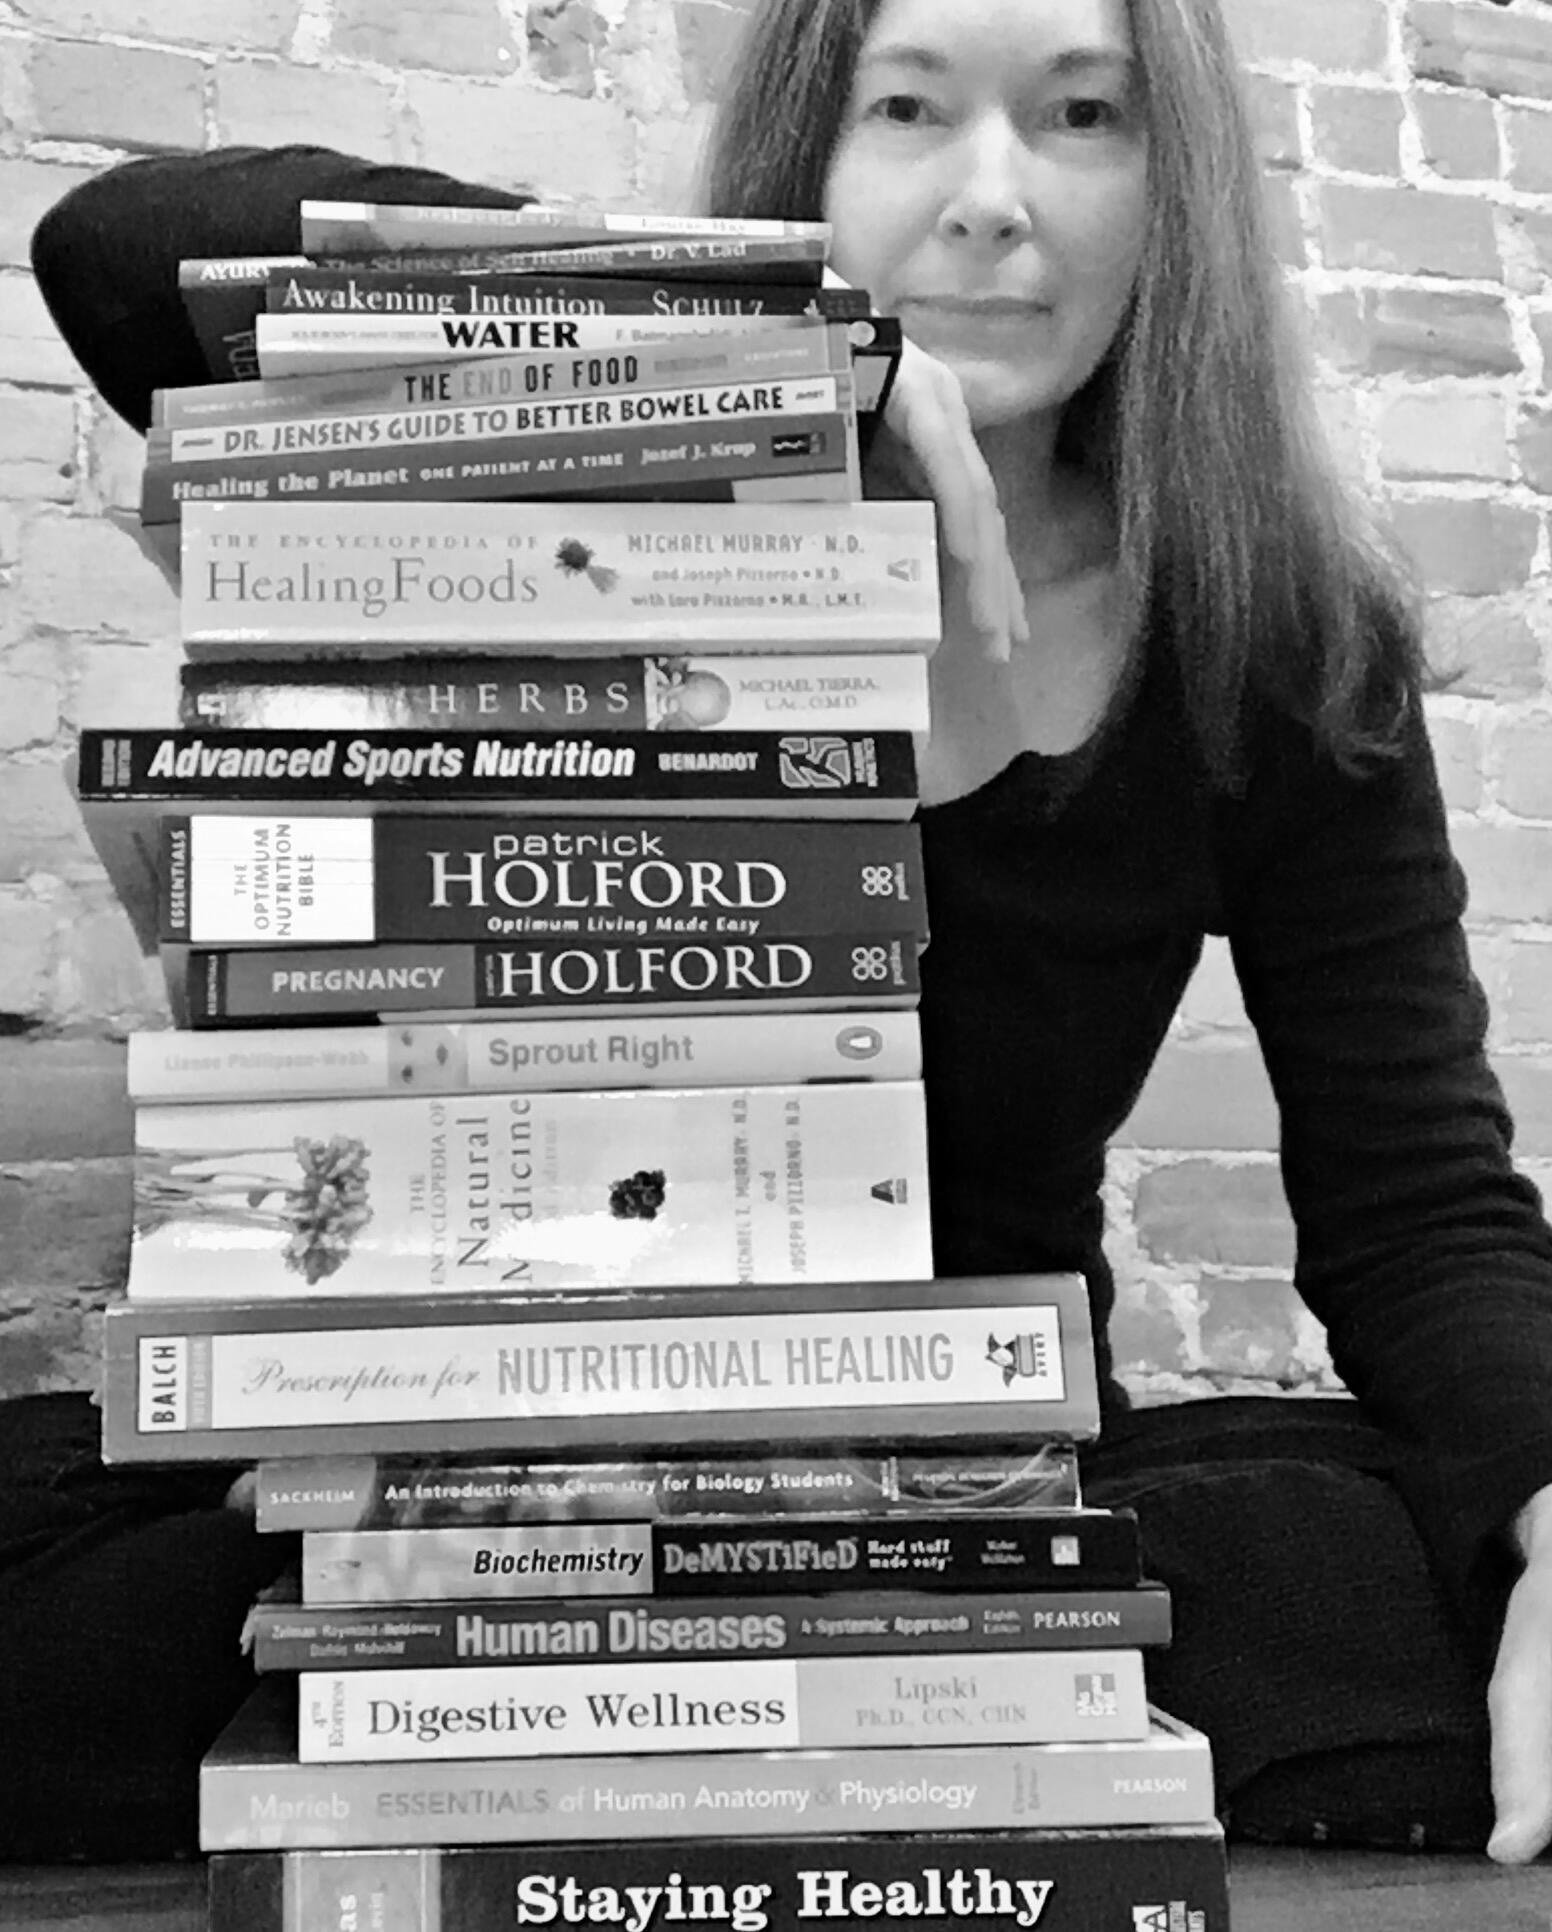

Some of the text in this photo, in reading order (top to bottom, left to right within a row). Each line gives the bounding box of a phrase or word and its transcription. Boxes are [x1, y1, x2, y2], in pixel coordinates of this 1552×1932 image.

[708, 240, 746, 258] Lad
[282, 278, 455, 315] Awakening
[470, 284, 604, 315] Intuition
[441, 320, 579, 349] WATER
[404, 373, 452, 402] THE
[463, 366, 511, 397] END
[524, 362, 554, 393] OF
[572, 355, 638, 389] FOOD
[272, 419, 380, 452] JENSEN'S
[387, 411, 466, 441] GUIDE
[473, 409, 507, 431] TO
[516, 401, 611, 430] BETTER
[620, 393, 710, 422] BOWEL
[717, 385, 784, 413] CARE
[172, 477, 270, 500] Healing
[278, 472, 319, 492] the
[328, 466, 409, 488] Planet
[419, 465, 455, 481] ONE
[461, 460, 531, 478] PATIENT
[536, 458, 557, 472] AT
[563, 457, 576, 470] A
[581, 452, 624, 468] TIME
[210, 534, 539, 550] THE ENCYCLOPEDIA OF
[627, 533, 715, 554] MICHAEL
[722, 533, 803, 554] MURRAY
[652, 566, 680, 581] and
[630, 592, 665, 606] with
[428, 681, 630, 716] HERBS
[738, 679, 814, 693] MICHAEL
[147, 739, 337, 779] Advanced
[342, 739, 465, 786] Sports
[472, 739, 636, 778] Nutrition
[658, 751, 759, 772] BENARDOT
[492, 829, 665, 860] patrick
[169, 829, 187, 929] ESSENTIALS
[233, 863, 248, 896] THE
[253, 827, 270, 931] OPTIMUM
[276, 823, 292, 937] NUTRITION
[298, 853, 315, 907] BIBLE
[426, 850, 788, 909] HOLFORD
[486, 915, 760, 935] Optimum Living Made Easy
[271, 966, 445, 993] PREGNANCY
[499, 943, 813, 997] HOLFORD
[488, 1032, 694, 1071] Sprout Right
[429, 1099, 447, 1127] OF
[409, 1172, 426, 1214] THE
[455, 1115, 490, 1268] Natural
[499, 1098, 533, 1284] Mdicine
[759, 1170, 776, 1202] and
[152, 1344, 177, 1425] BALCH
[241, 1332, 954, 1403] Prescription for NUTRITIONAL HEALING
[269, 1489, 356, 1506] SACKHEIM
[384, 1484, 410, 1501] An
[415, 1480, 532, 1501] Introduction
[537, 1482, 557, 1498] to
[662, 1476, 691, 1493] for
[696, 1473, 765, 1496] Biology
[770, 1471, 853, 1490] Students
[473, 1545, 644, 1576] Biochemistry
[867, 1538, 905, 1555] Hard
[910, 1538, 951, 1555] stuff
[455, 1614, 599, 1659] Human
[607, 1609, 787, 1655] Diseases
[814, 1617, 889, 1638] Systemic
[894, 1614, 970, 1637] Approach
[1032, 1610, 1121, 1630] PEARSON
[894, 1676, 978, 1704] Lipski
[368, 1691, 787, 1743] Digestive Wellness
[249, 1793, 350, 1821] Marieb
[375, 1787, 551, 1818] ESSENTIALS
[558, 1786, 586, 1812] of
[593, 1785, 687, 1812] Human
[693, 1783, 811, 1812] Anatomy
[839, 1779, 979, 1810] Physiology
[1112, 1777, 1188, 1795] PEARSON
[517, 1867, 1054, 1932] Staying Healthy
